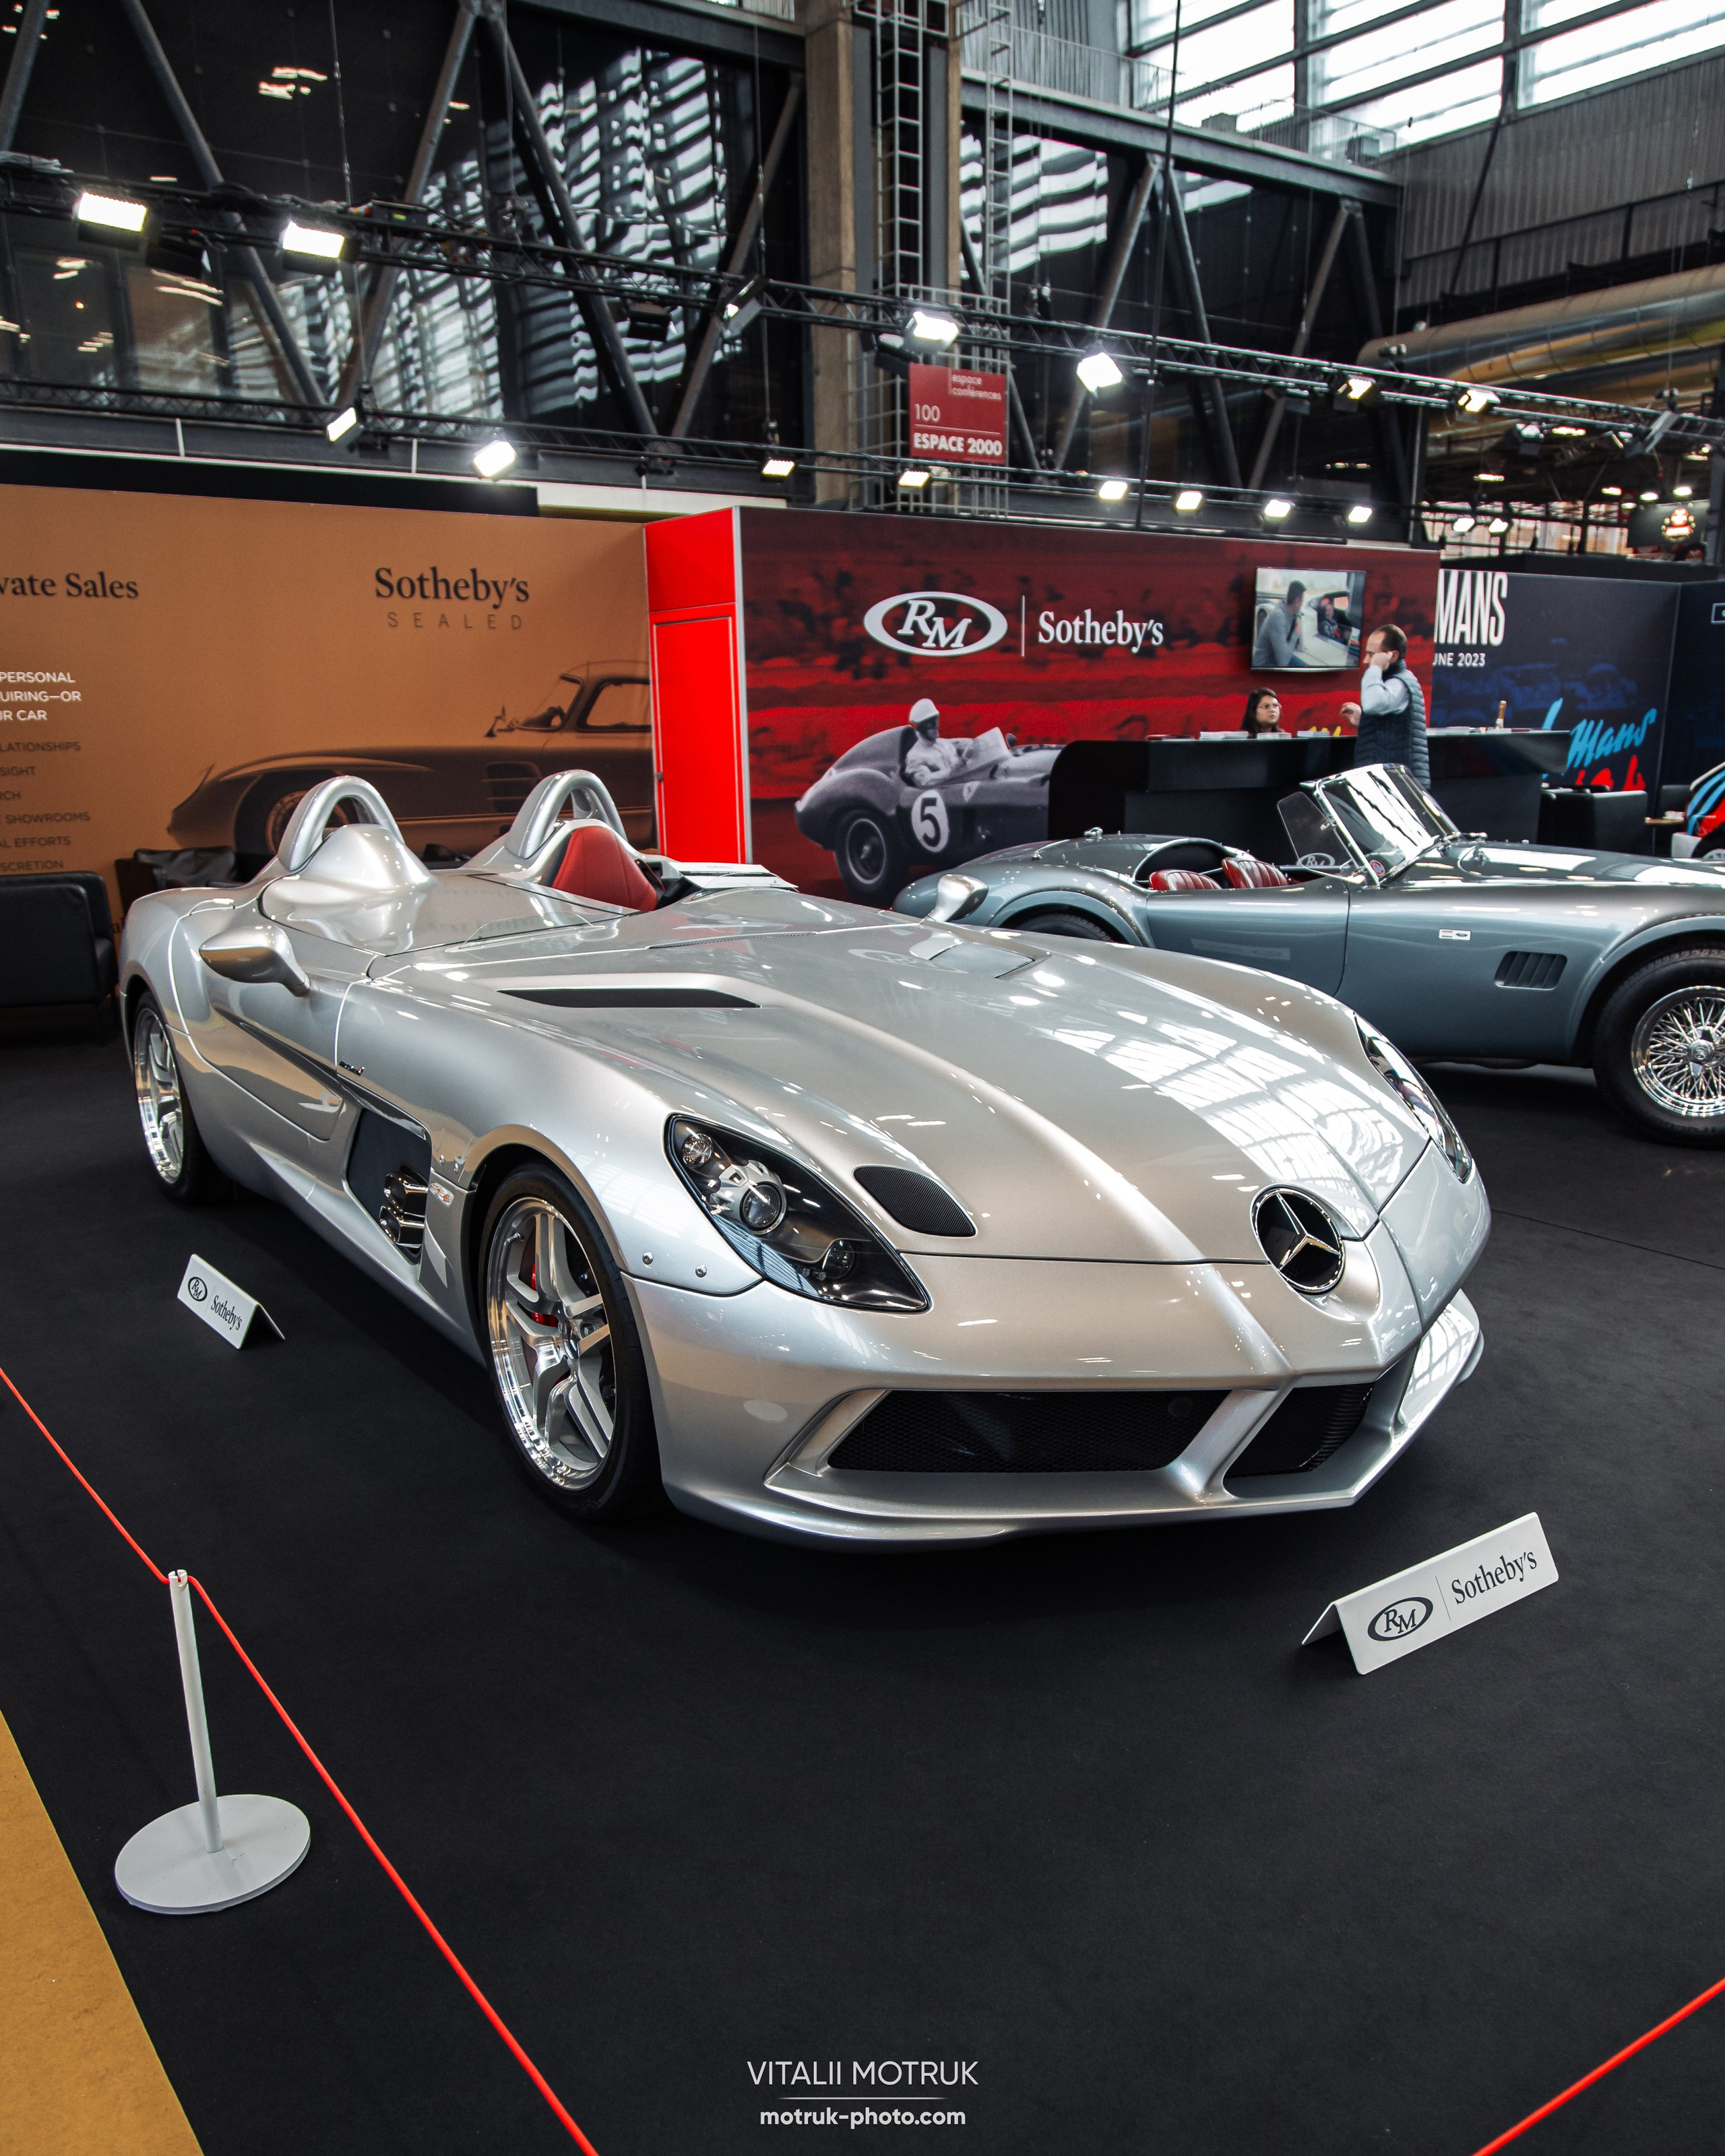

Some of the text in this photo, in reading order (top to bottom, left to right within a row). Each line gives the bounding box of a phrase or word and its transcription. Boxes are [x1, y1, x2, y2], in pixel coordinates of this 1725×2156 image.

[952, 375, 982, 386] espace
[914, 404, 941, 422] 100
[913, 432, 1003, 456] ESPACE 2000
[65, 571, 139, 599] Sales
[375, 565, 530, 610] Sotheby's
[1433, 568, 1508, 646] MANS
[387, 611, 523, 630] SEALED
[898, 599, 1164, 654] RM Sotheby's
[1456, 652, 1486, 668] 2023
[0, 672, 76, 683] PERSONAL
[16, 709, 48, 721] CAR
[5, 812, 91, 824] SHOWROOMS
[920, 797, 941, 848] 5
[14, 835, 71, 848] EFFORTS
[210, 1294, 243, 1331] Sotheby's
[1451, 1552, 1538, 1605] Sotheby's
